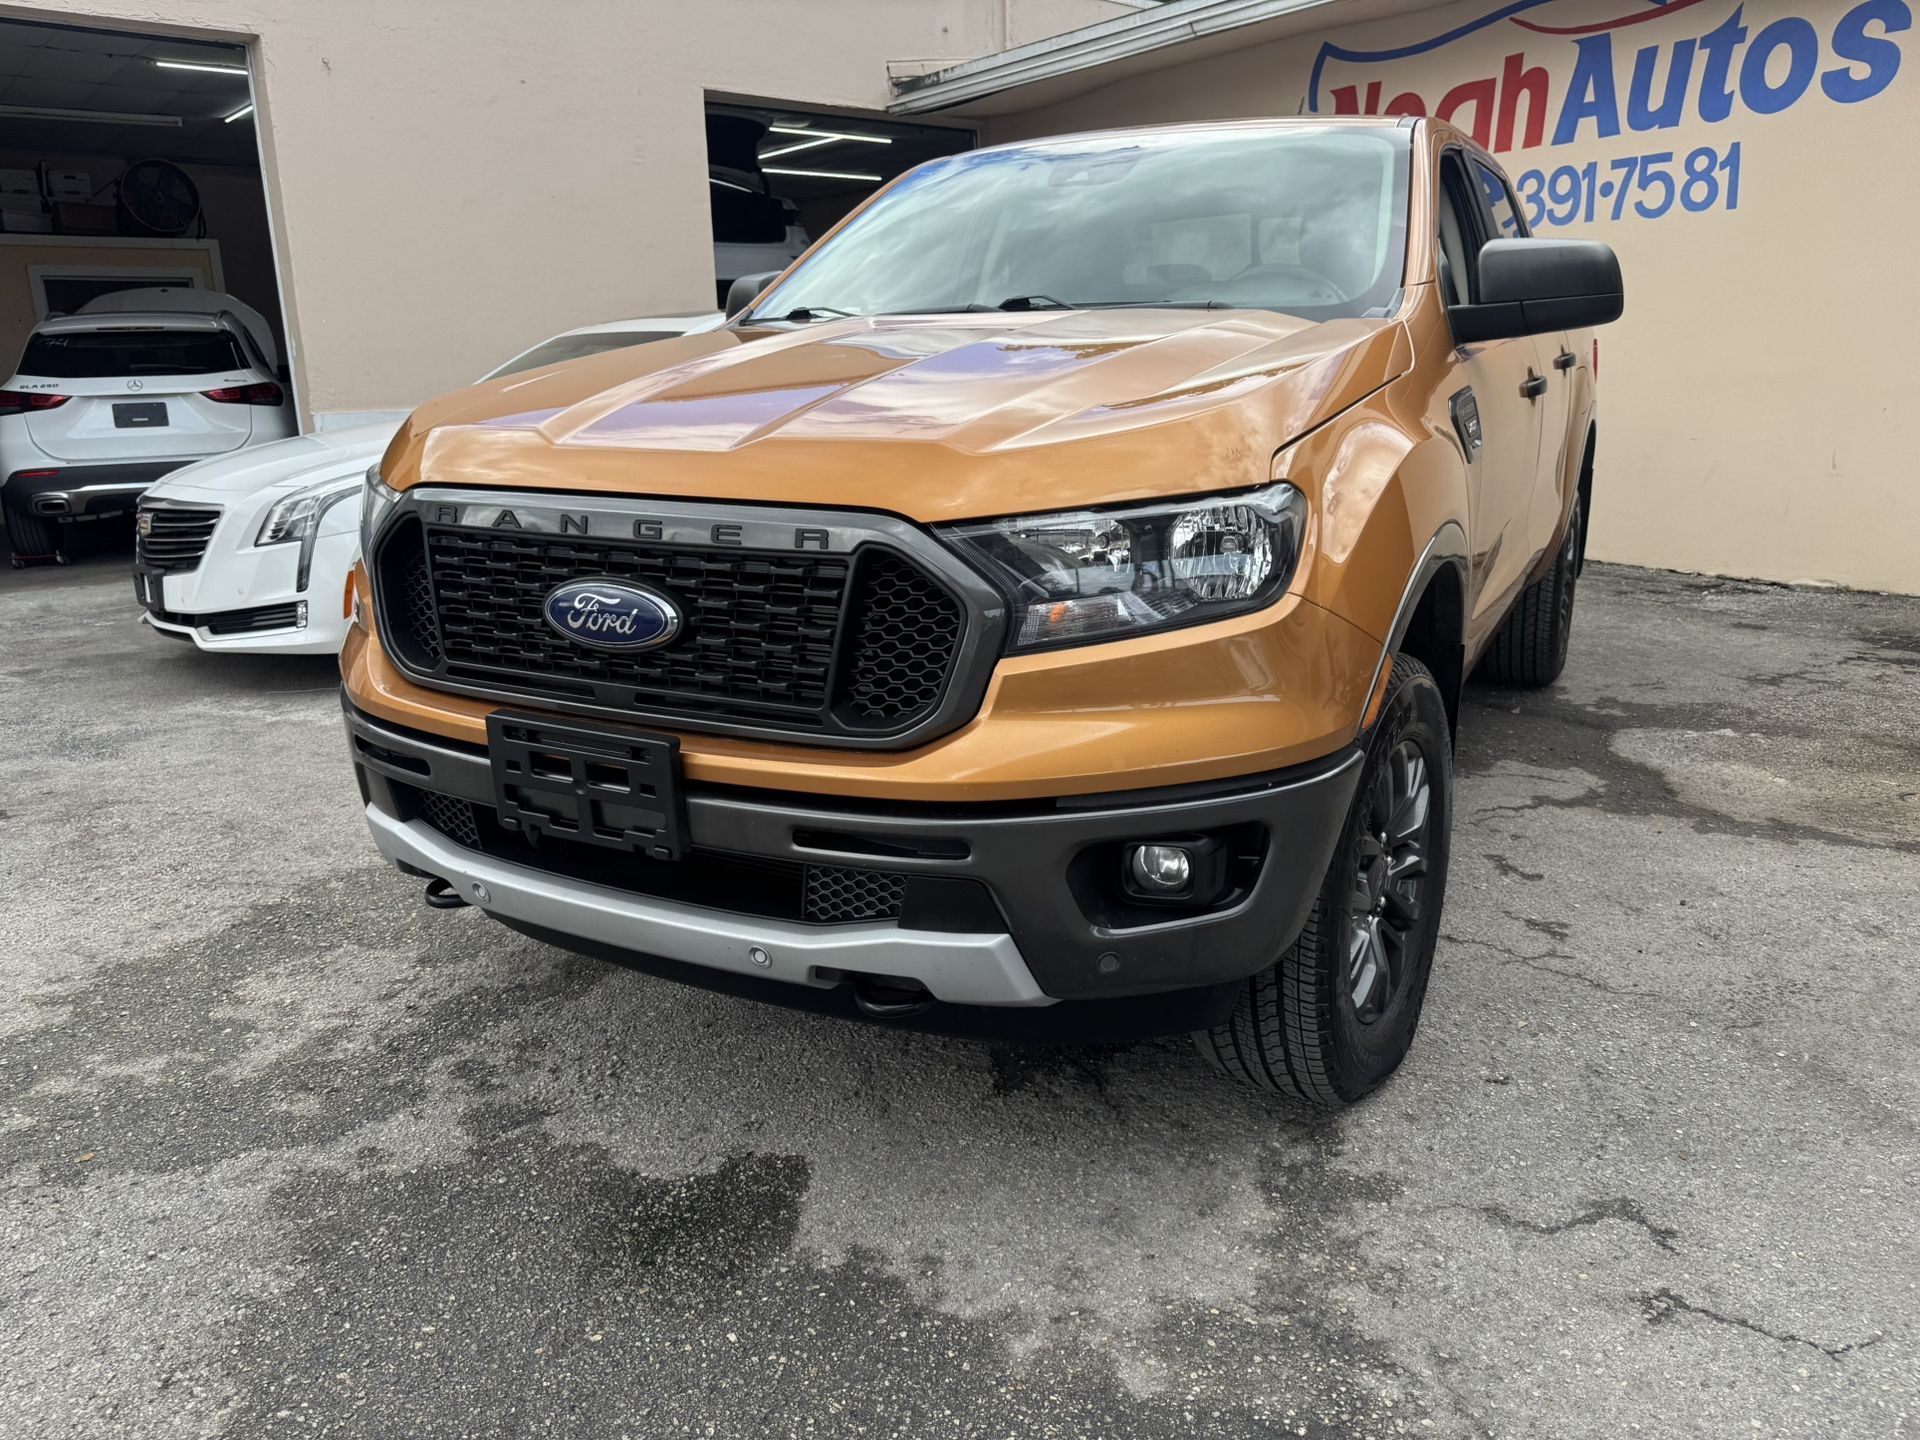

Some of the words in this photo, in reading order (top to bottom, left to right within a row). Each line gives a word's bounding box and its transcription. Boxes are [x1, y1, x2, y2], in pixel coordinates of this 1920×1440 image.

[1551, 0, 1912, 146] Autos
[435, 503, 830, 550] RANGER
[565, 592, 638, 636] Ford
